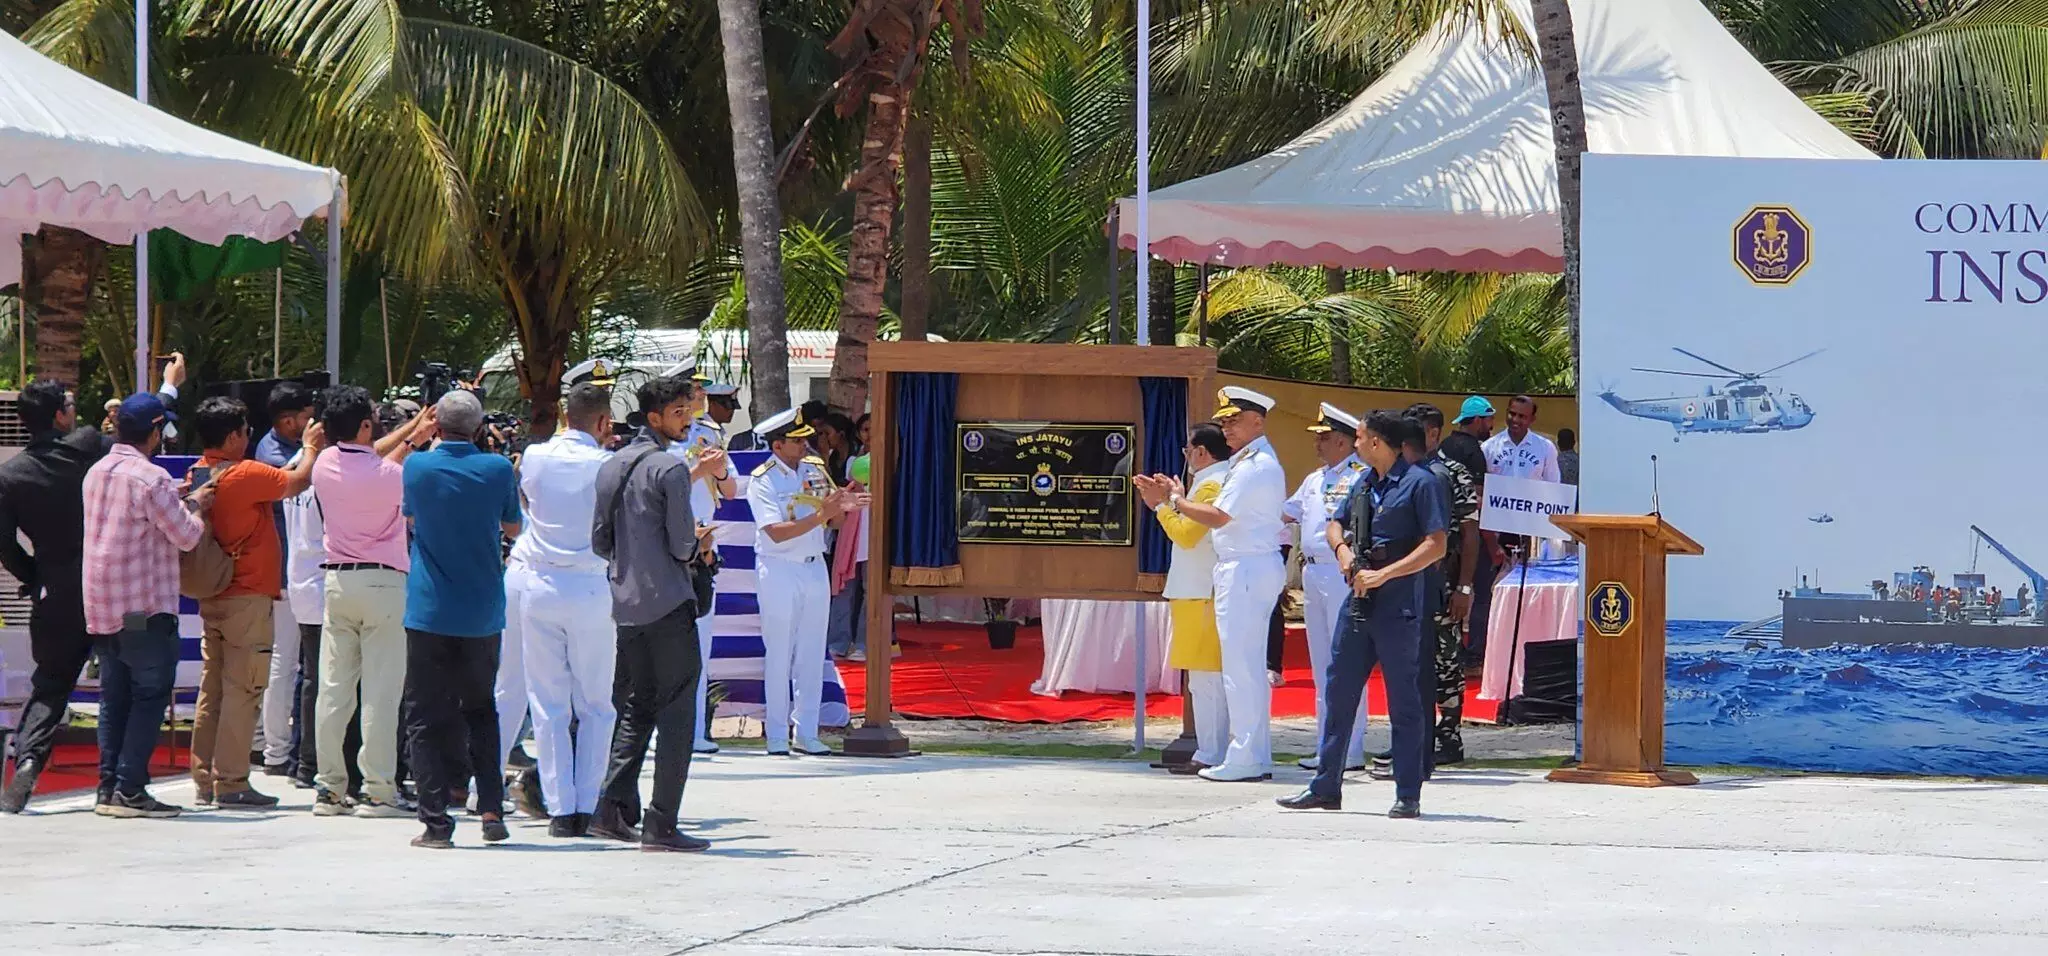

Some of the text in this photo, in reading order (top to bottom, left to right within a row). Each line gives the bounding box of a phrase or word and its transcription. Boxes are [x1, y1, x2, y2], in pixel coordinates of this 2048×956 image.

[1915, 203, 2048, 233] COMM
[1925, 250, 2048, 304] INS
[1703, 402, 1715, 420] W
[1015, 433, 1073, 447] INS JATAYU
[1489, 495, 1570, 515] WATER POINT
